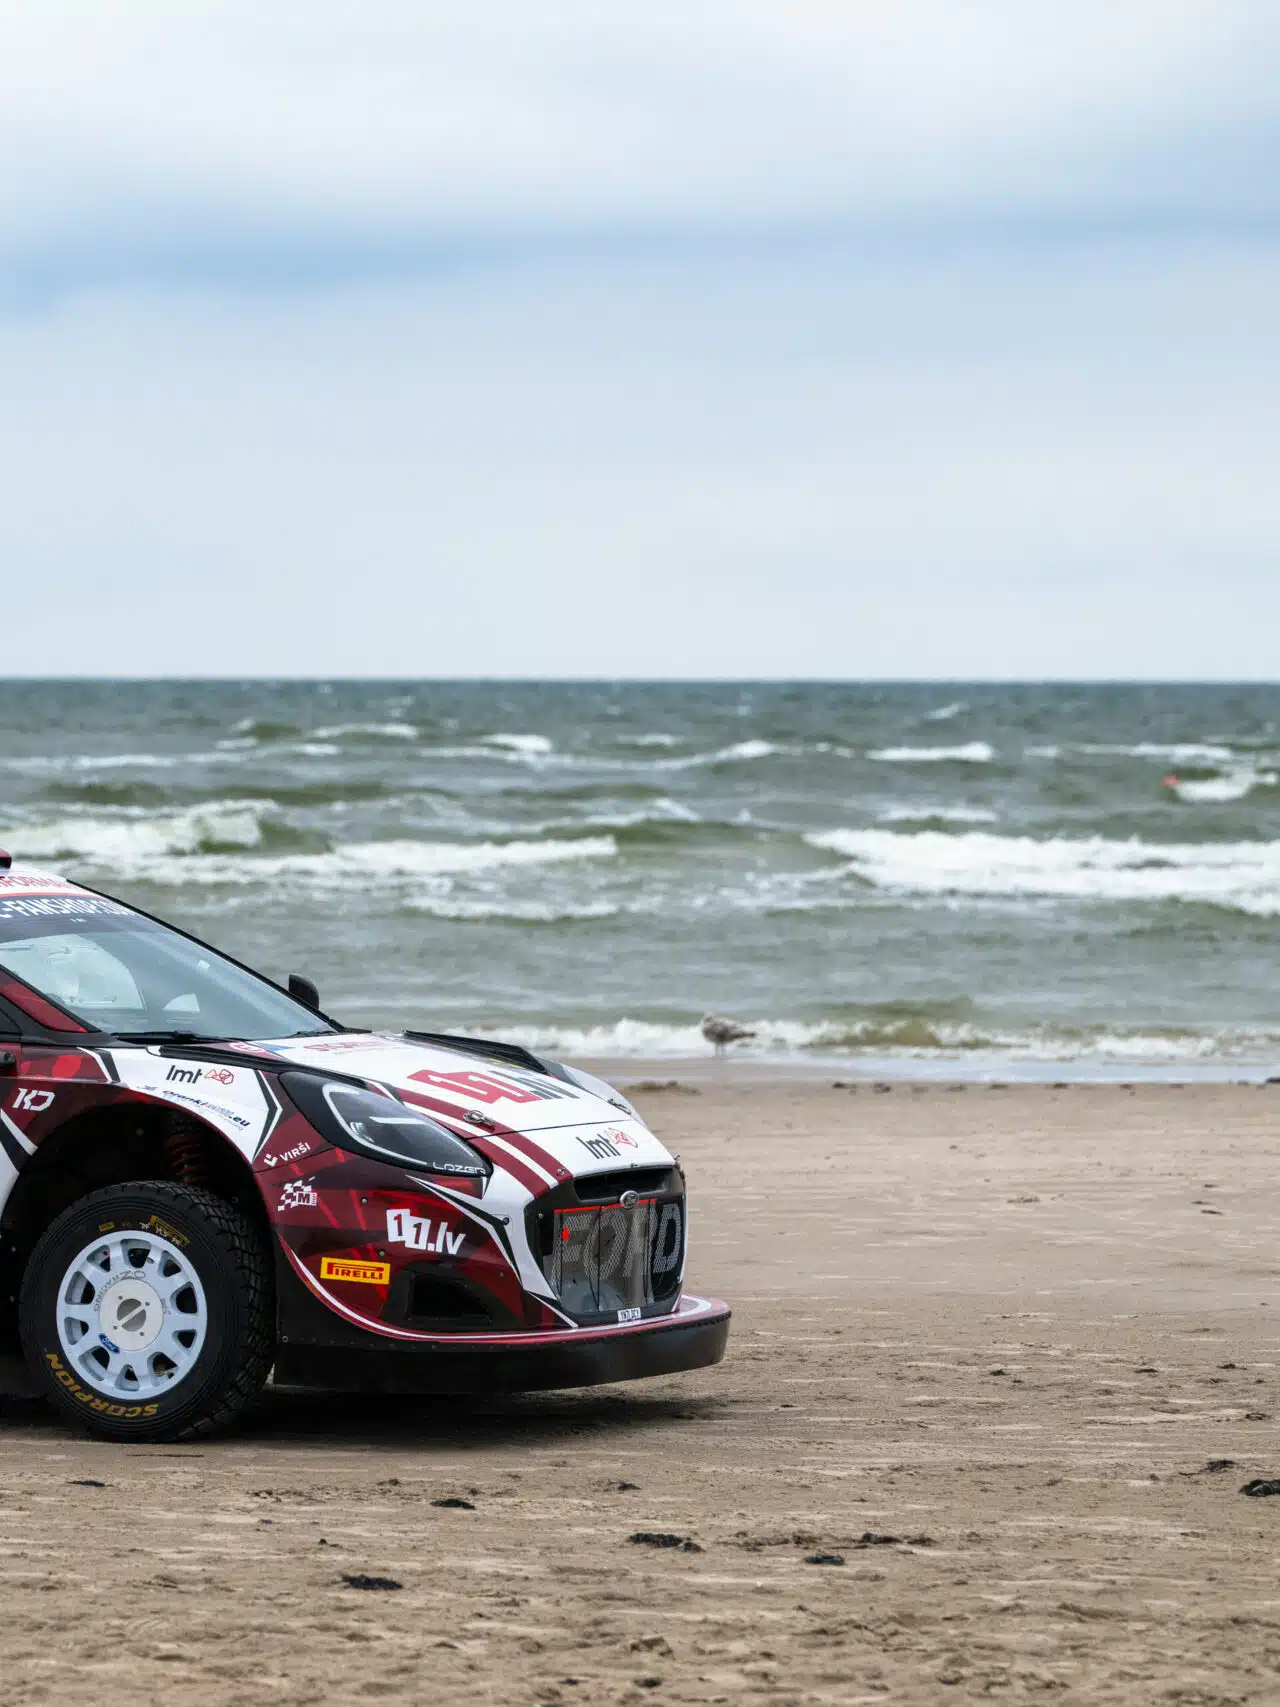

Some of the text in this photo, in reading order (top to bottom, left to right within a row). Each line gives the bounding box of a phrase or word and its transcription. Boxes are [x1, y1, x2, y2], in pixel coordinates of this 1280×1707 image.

[166, 1065, 204, 1084] lmt
[280, 1142, 311, 1162] VIRŠI
[576, 1135, 621, 1160] lmt
[386, 1209, 466, 1256] 11.lv
[551, 1203, 680, 1286] FORD
[327, 1261, 384, 1280] PIRELLI
[45, 1353, 159, 1419] SCORPION
